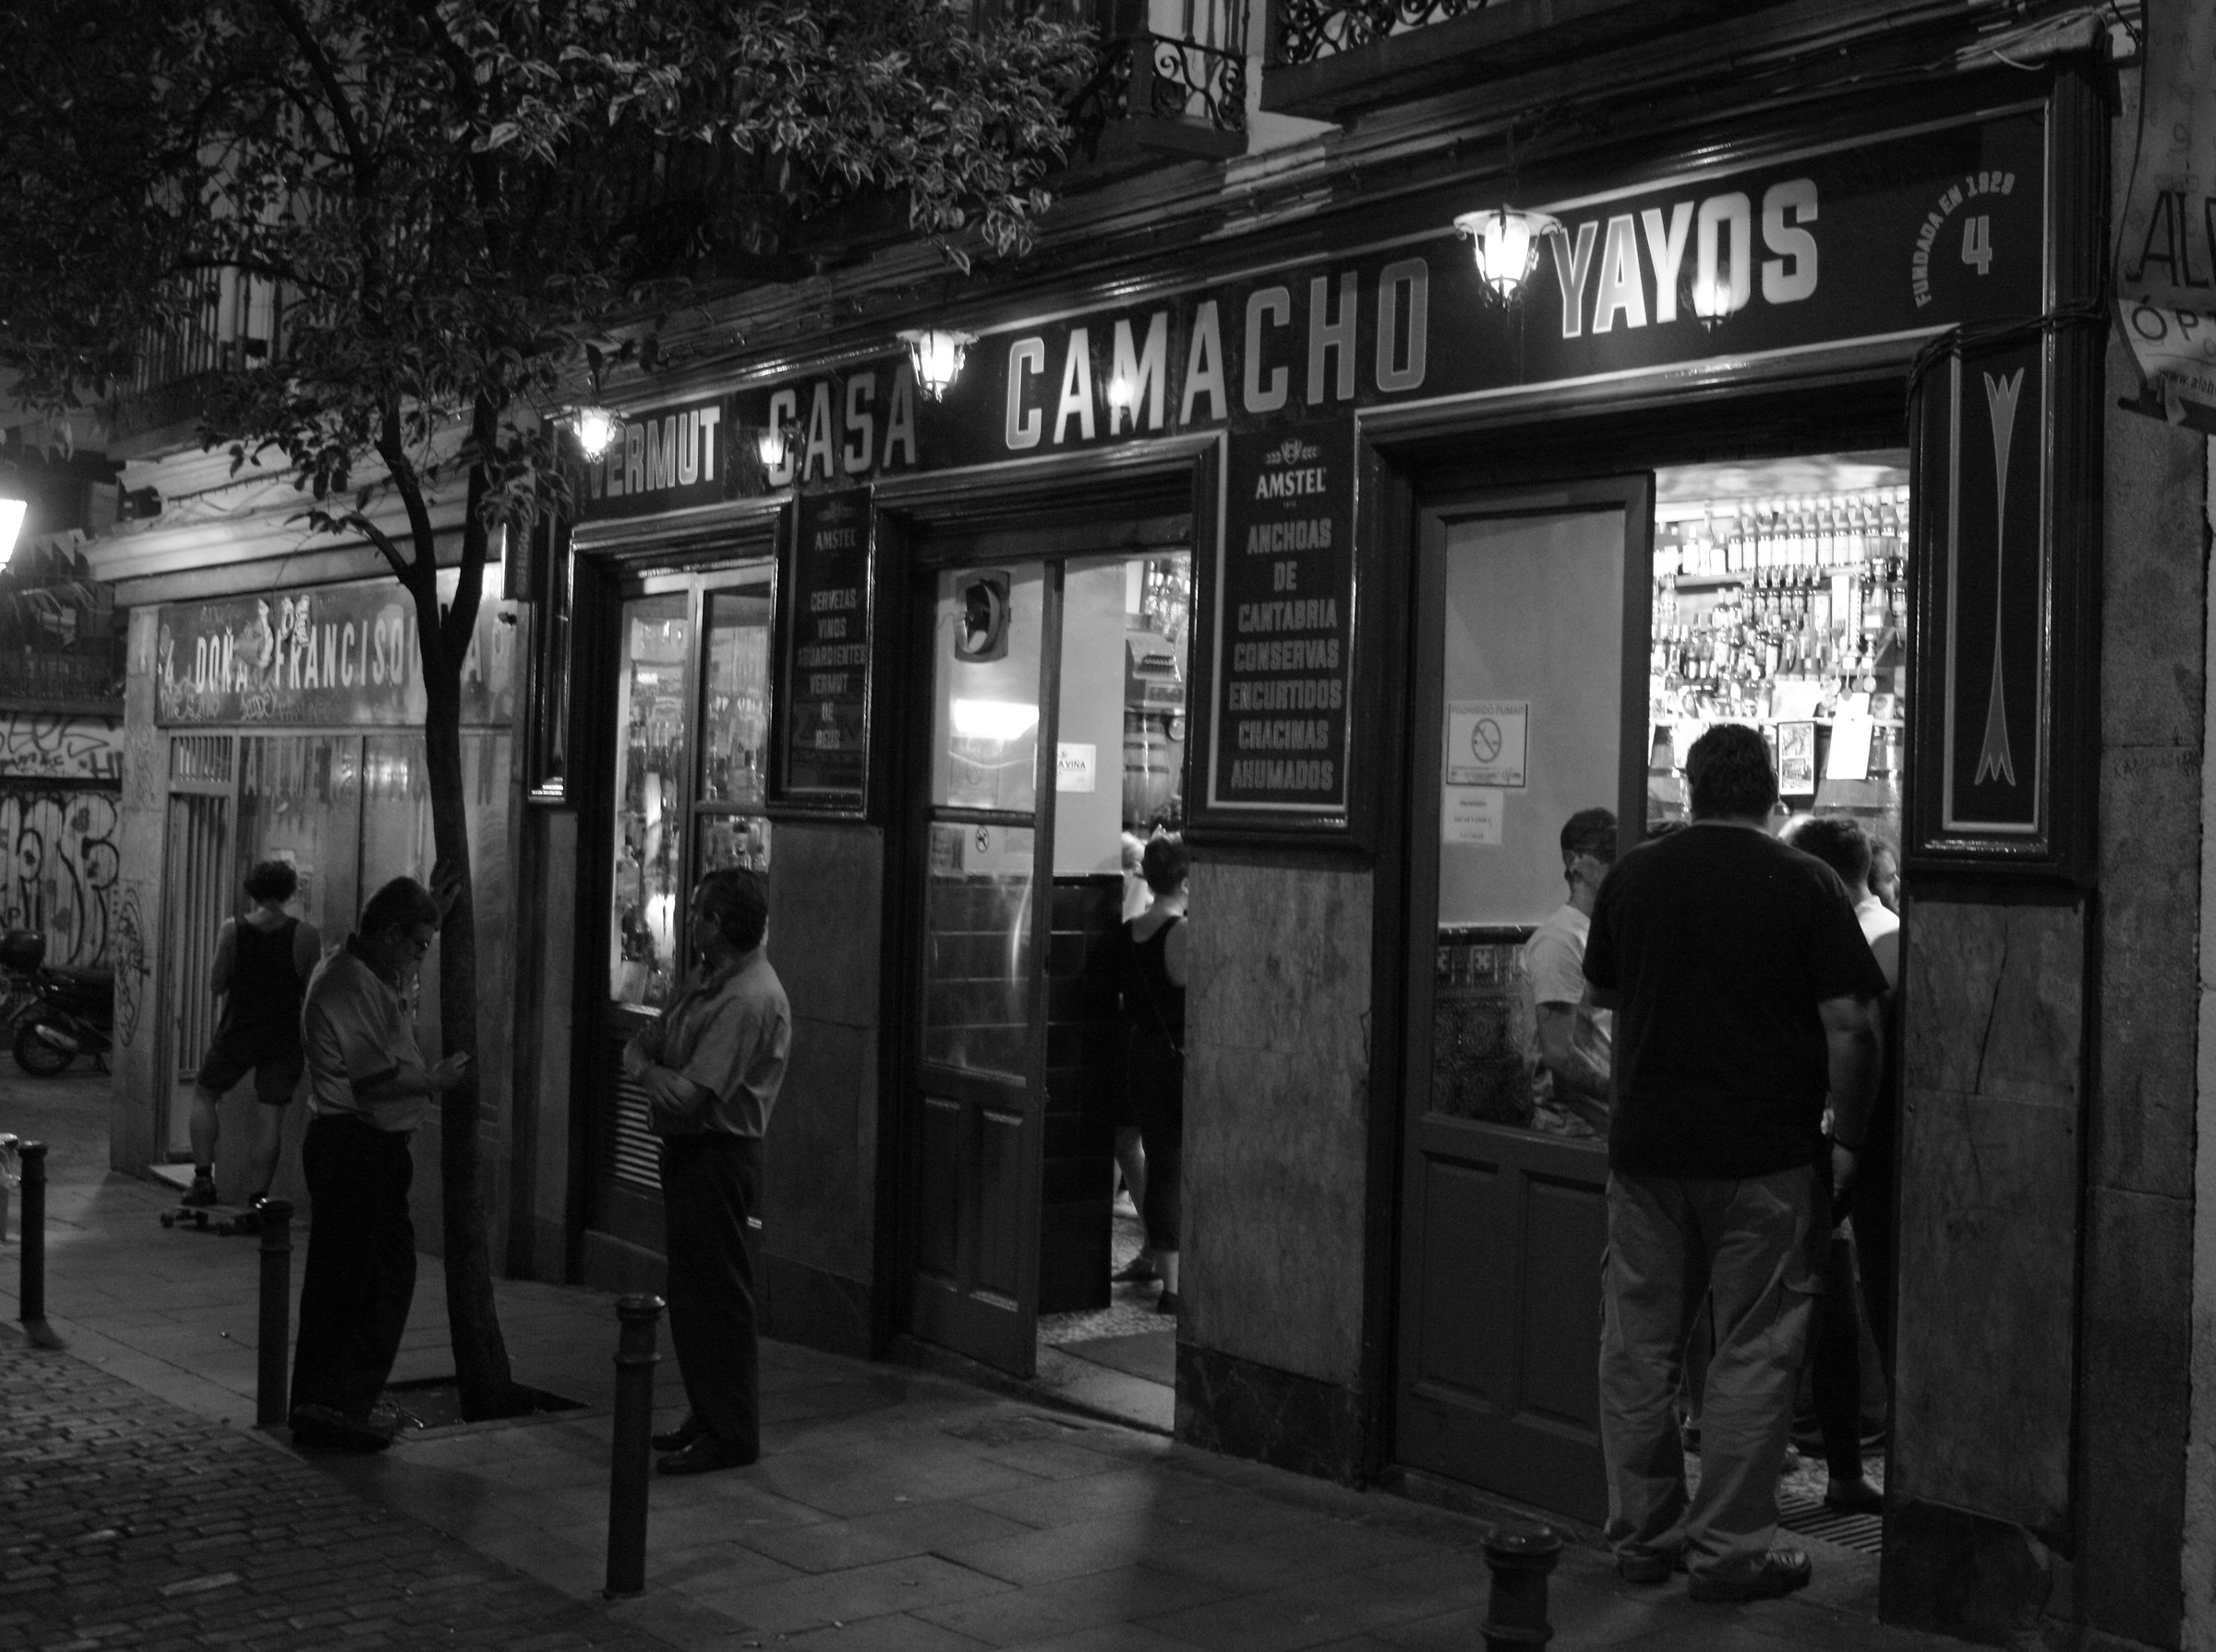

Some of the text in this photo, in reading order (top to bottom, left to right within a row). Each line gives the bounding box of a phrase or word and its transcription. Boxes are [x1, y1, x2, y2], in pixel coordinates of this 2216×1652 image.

[1911, 211, 1944, 307] FUNDADA
[1938, 185, 1963, 215] EN
[1962, 215, 1993, 275] 4
[768, 364, 917, 487] CASA
[1006, 258, 1428, 450] CAMACHO
[1551, 178, 1818, 339] YAYOS
[1256, 467, 1327, 500] AMSTEL
[814, 527, 857, 551] AMSTEL
[1247, 518, 1331, 554] ANCHOAS
[1274, 561, 1297, 591] DE
[810, 587, 857, 612] CERVEZAS
[1238, 598, 1337, 633] CANTABRIA
[818, 617, 847, 639] VINOS
[1234, 638, 1340, 671] CONSERVAS
[810, 673, 849, 694] VERMUT
[1229, 679, 1342, 711] ENCURTIDOS
[1238, 720, 1330, 750] CHACINAS
[1231, 760, 1333, 790] AHUMADOS
